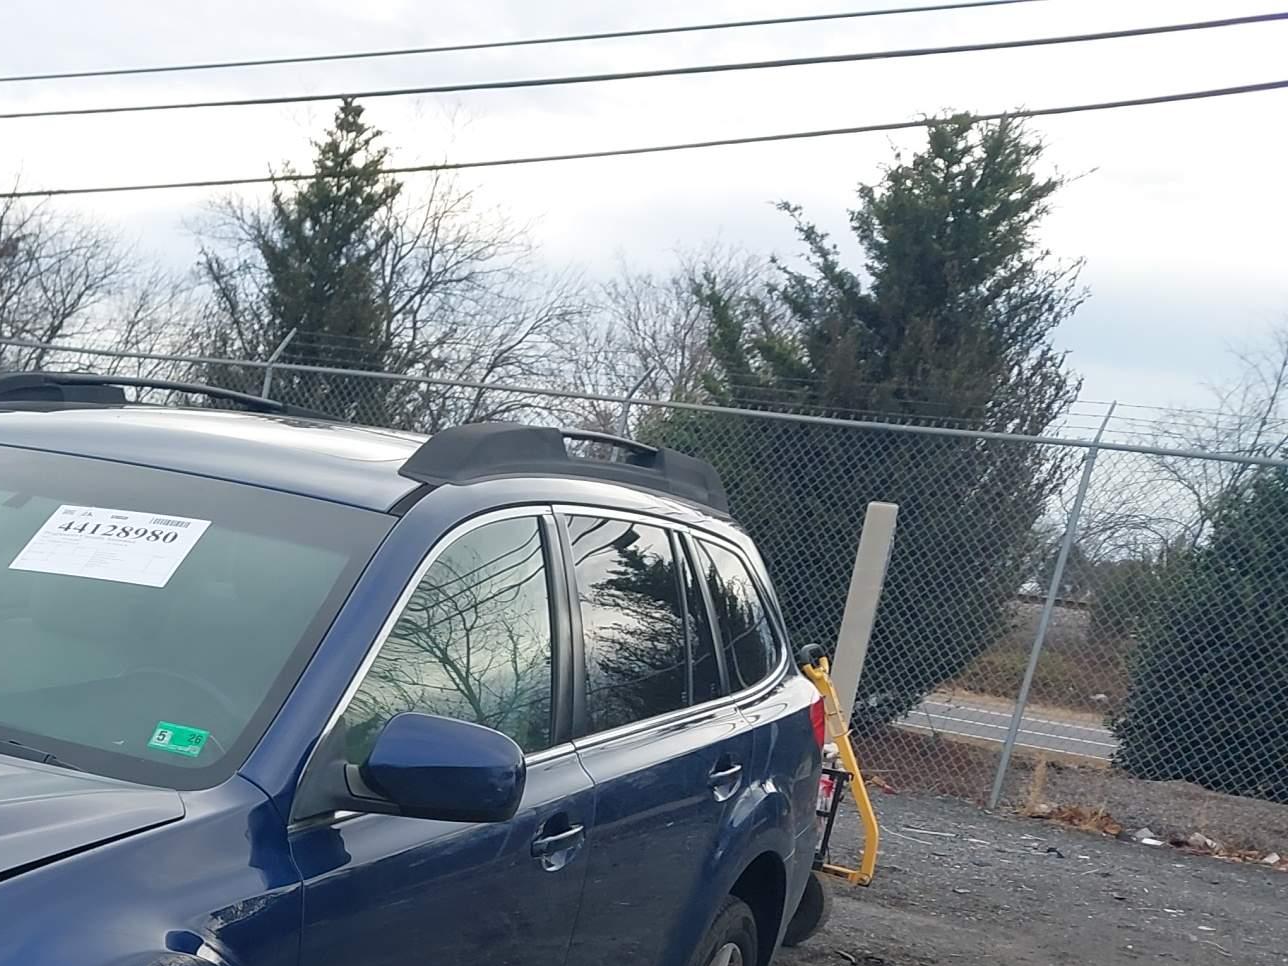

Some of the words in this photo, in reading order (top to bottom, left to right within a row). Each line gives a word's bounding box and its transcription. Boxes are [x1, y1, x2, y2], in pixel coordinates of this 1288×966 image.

[58, 520, 179, 544] 44128980
[157, 730, 168, 742] 5
[188, 733, 204, 745] 26
